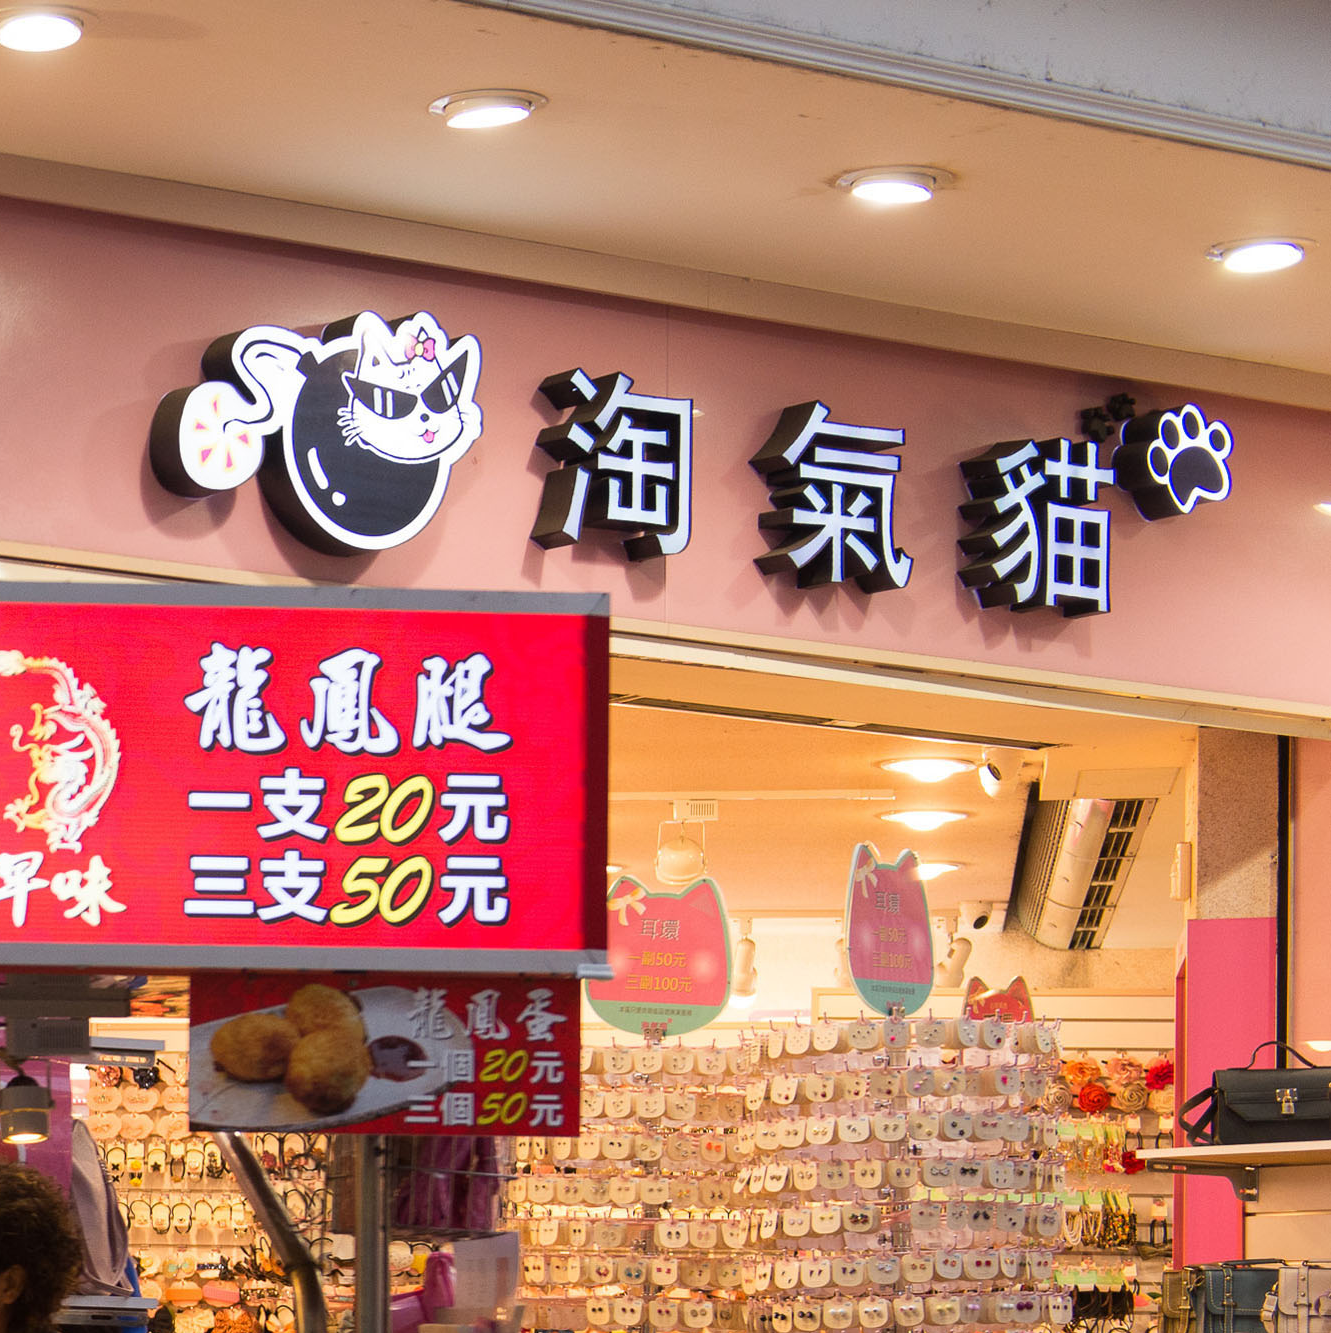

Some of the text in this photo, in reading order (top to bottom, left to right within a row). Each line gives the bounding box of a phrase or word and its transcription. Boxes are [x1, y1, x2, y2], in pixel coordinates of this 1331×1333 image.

[545, 366, 1115, 614] 淘氣貓
[182, 640, 514, 757] 龍鳳腿
[183, 769, 511, 848] 一支20元
[181, 851, 511, 928] 三支50元
[407, 986, 567, 1042] 龍鳳蛋
[406, 1048, 565, 1084] 一個20元
[404, 1091, 564, 1127] 三個50元
